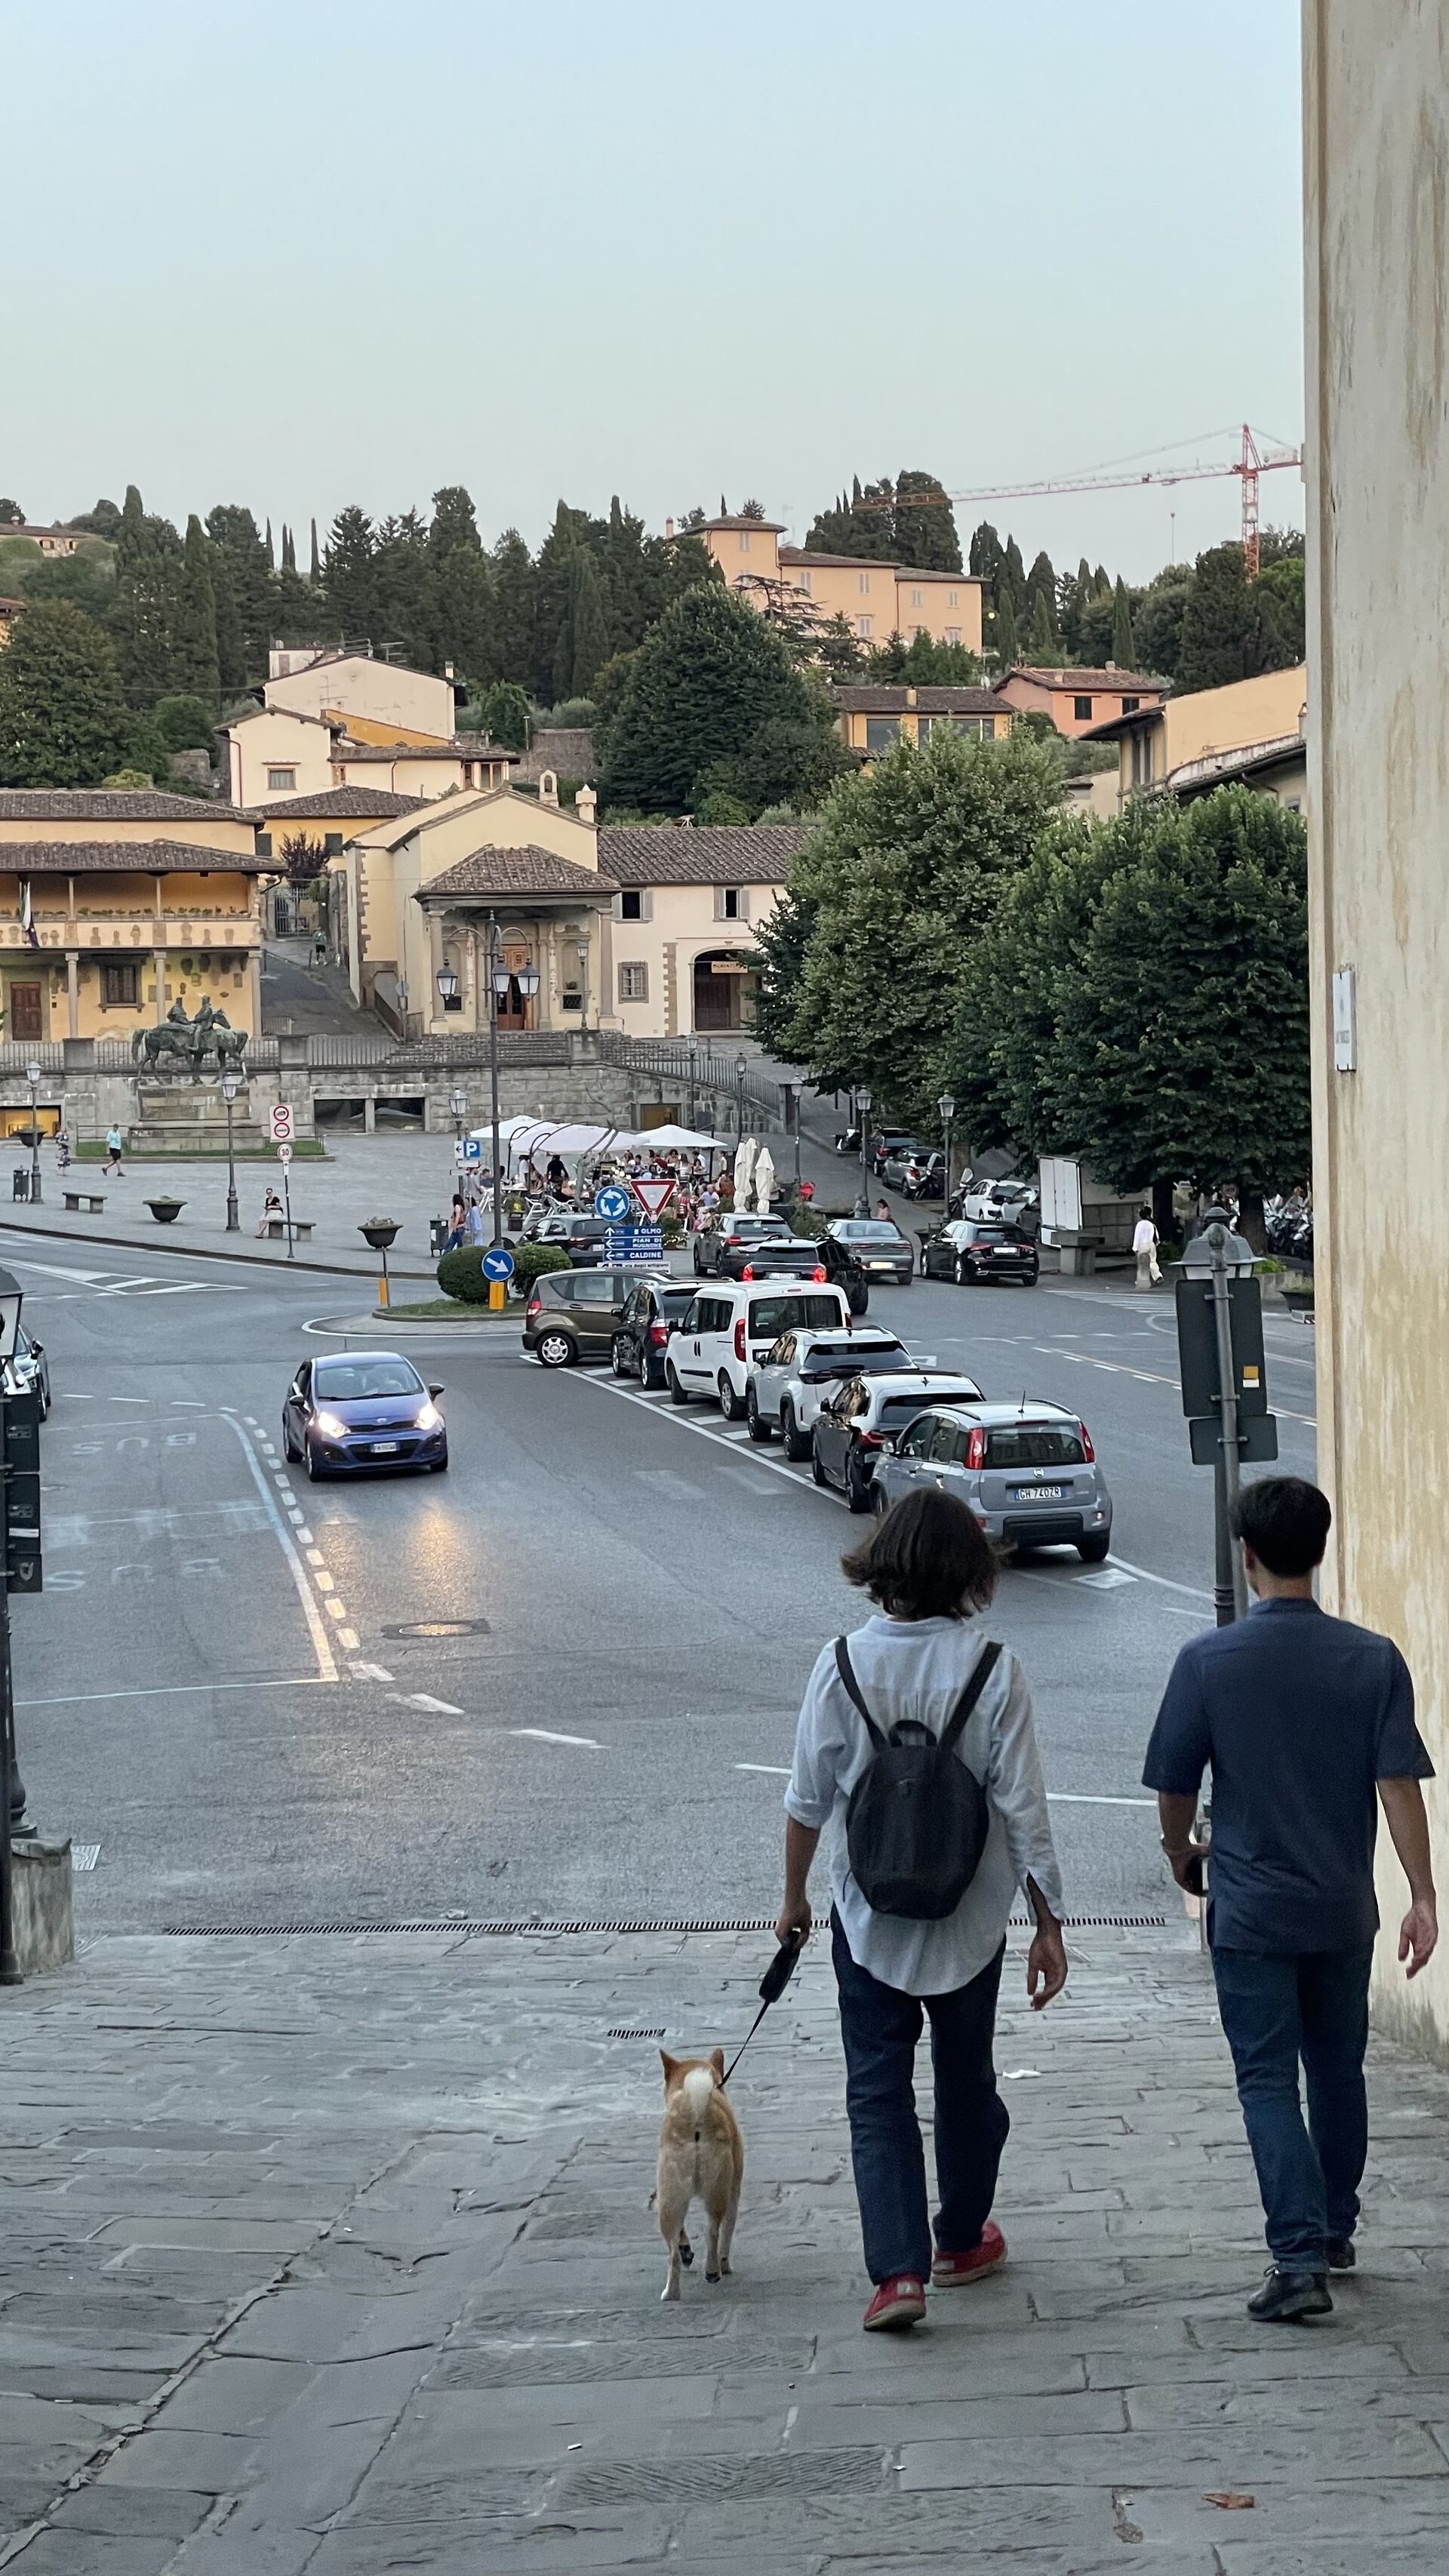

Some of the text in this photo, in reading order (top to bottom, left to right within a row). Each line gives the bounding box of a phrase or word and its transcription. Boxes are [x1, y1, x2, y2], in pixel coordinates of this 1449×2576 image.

[281, 1148, 290, 1156] 30
[466, 1142, 478, 1157] P
[72, 1433, 197, 1455] BUS
